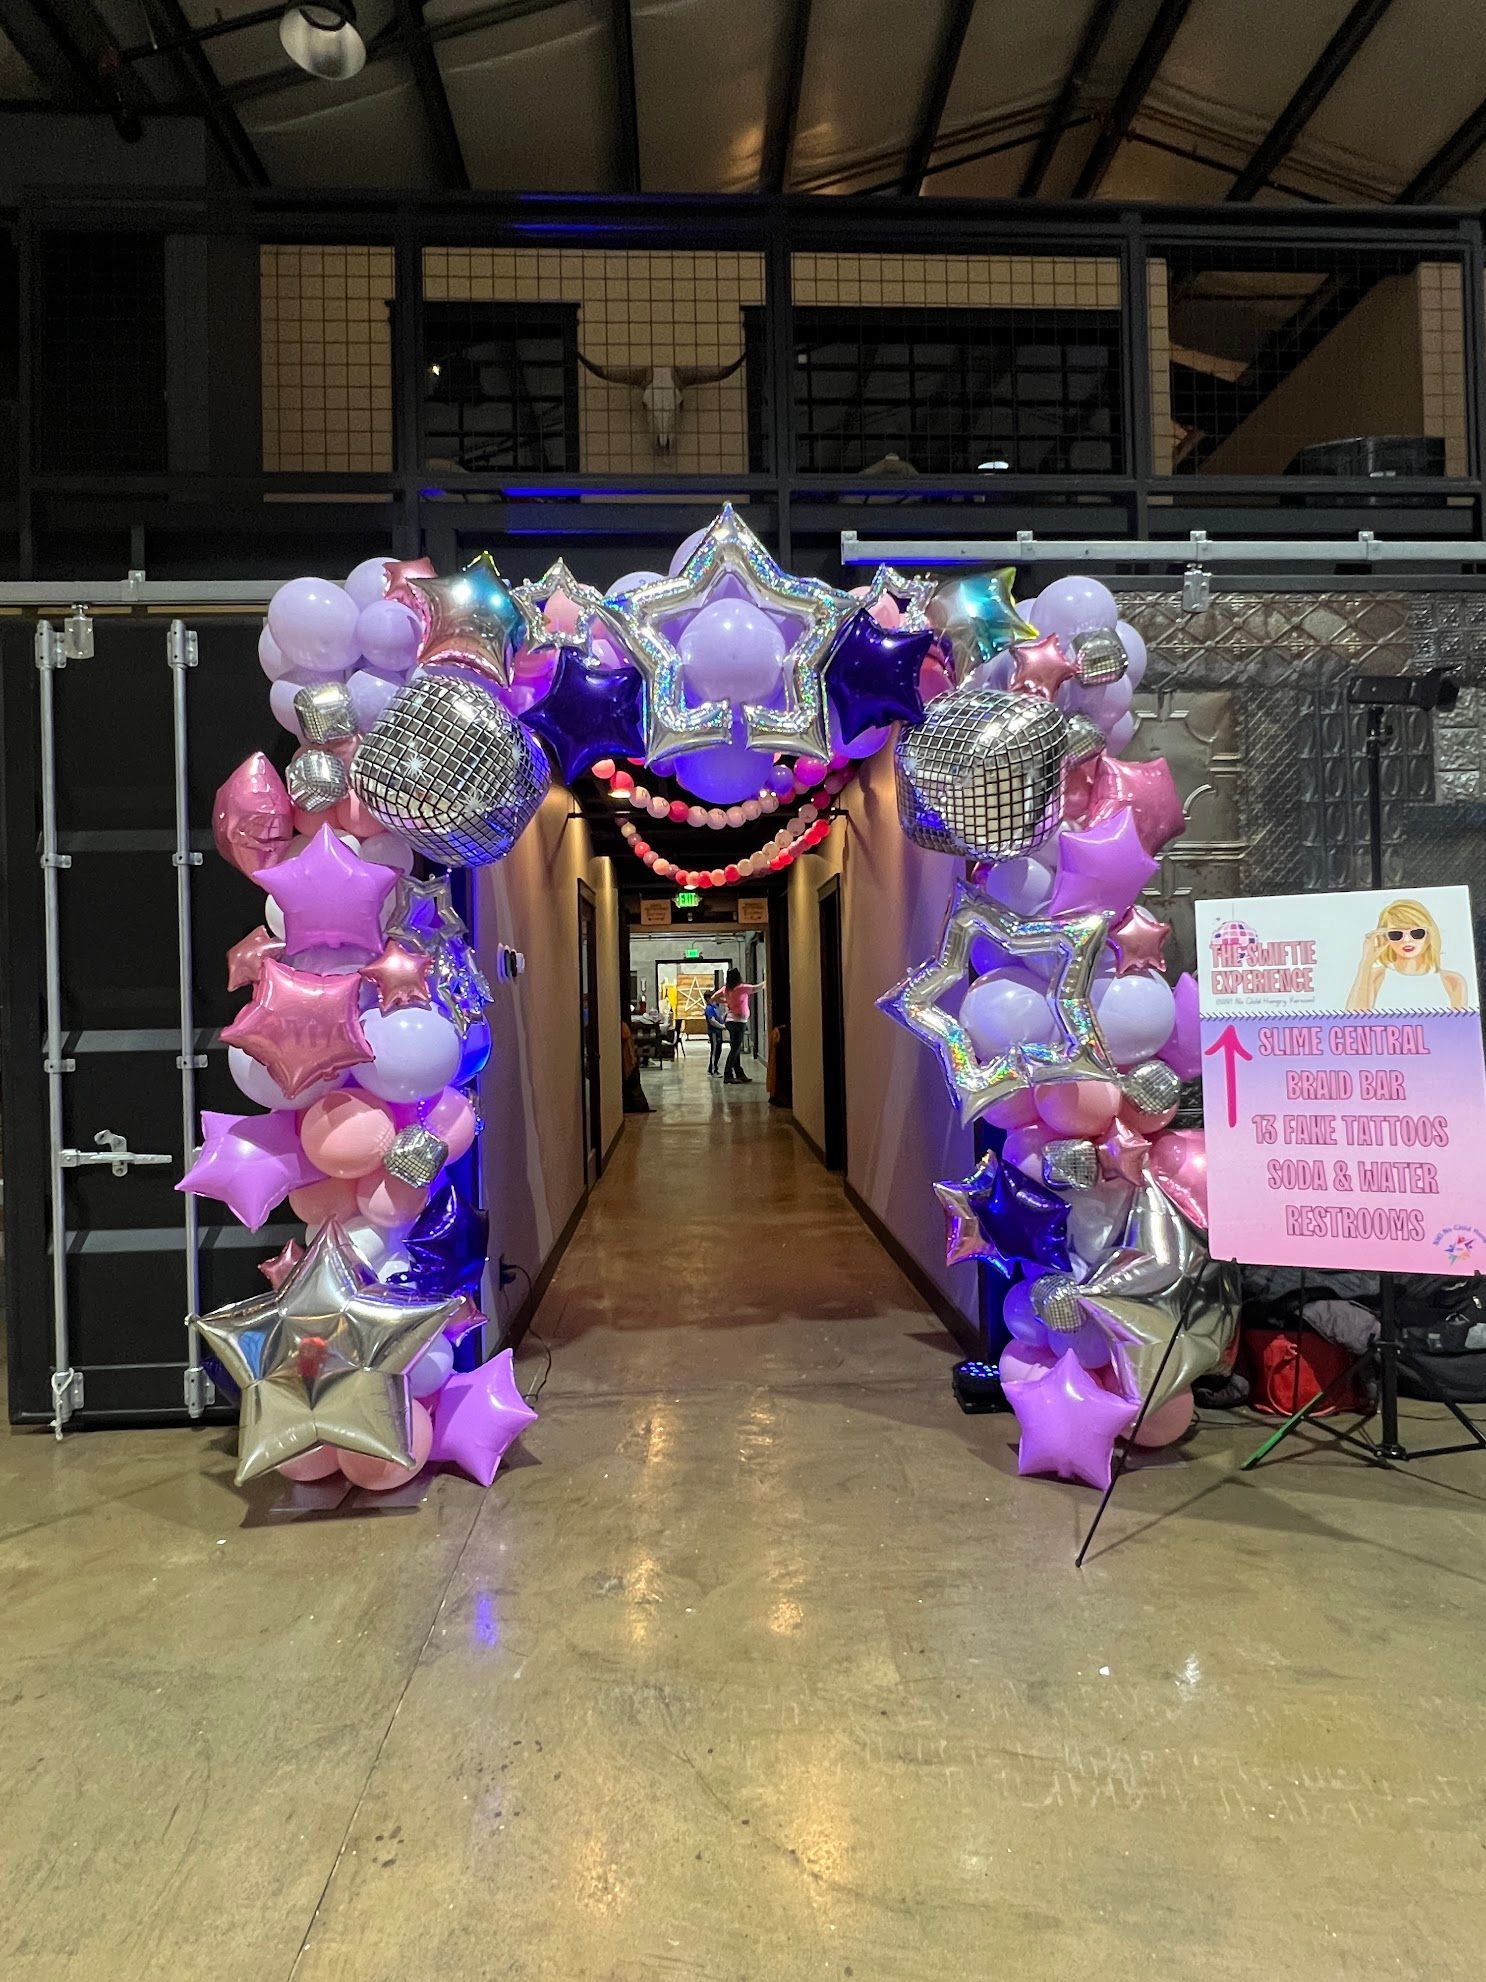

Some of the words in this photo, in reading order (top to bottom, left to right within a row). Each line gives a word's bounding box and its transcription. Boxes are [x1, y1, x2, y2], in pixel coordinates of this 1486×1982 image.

[1210, 943, 1246, 968] THE
[1247, 940, 1317, 966] SWIFTIE
[1211, 967, 1314, 994] EXPERIENCE
[1258, 1026, 1323, 1056] SLIME
[1329, 1025, 1430, 1055] CENTRAL
[1286, 1070, 1353, 1100] BRAID
[1359, 1070, 1406, 1100] BAR
[1252, 1114, 1277, 1145] 13
[1283, 1114, 1337, 1146] FAKE
[1342, 1115, 1449, 1147] TATTOOS
[1267, 1159, 1326, 1191] SODA
[1333, 1161, 1352, 1192] &
[1357, 1161, 1439, 1194] WATER
[1285, 1205, 1425, 1242] RESTROOMS
